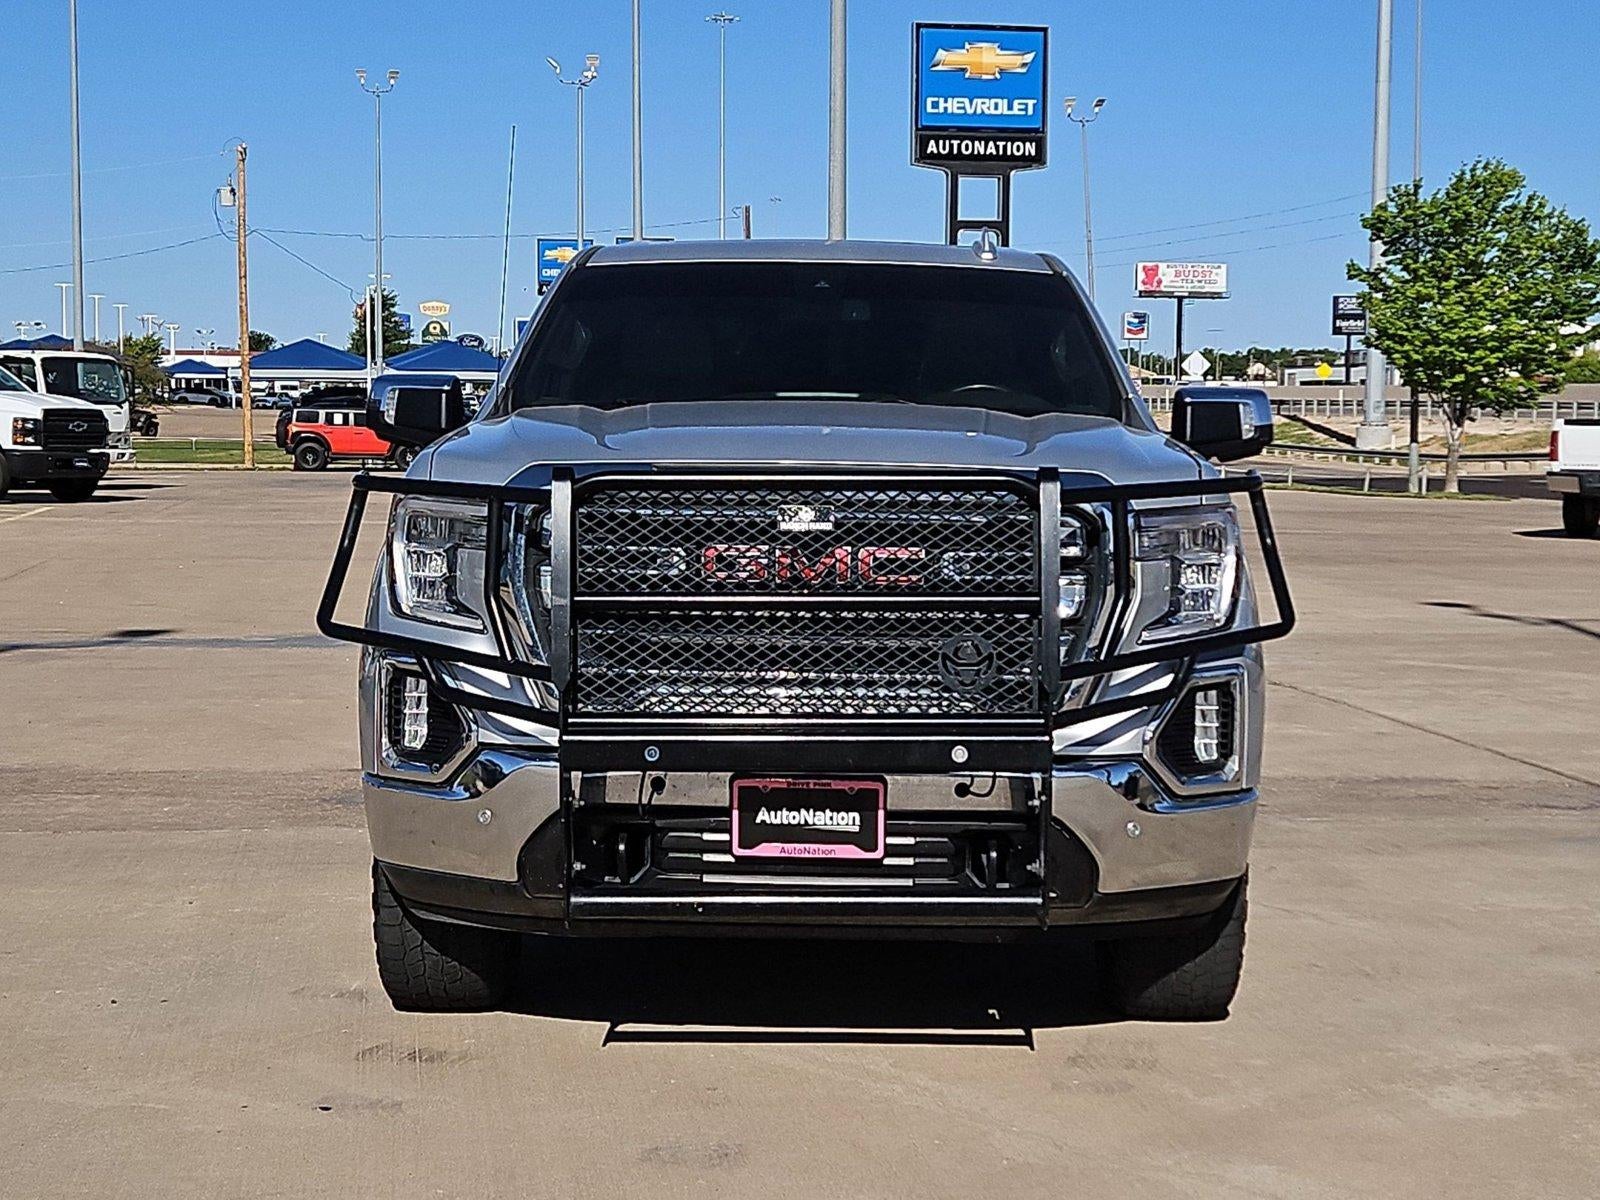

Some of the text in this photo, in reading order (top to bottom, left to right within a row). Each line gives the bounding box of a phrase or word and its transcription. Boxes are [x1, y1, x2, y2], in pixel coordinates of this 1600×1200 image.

[926, 97, 1037, 115] CHEVROLET
[926, 139, 1036, 156] AUTONATION
[1174, 269, 1214, 279] BUDS?
[702, 545, 925, 584] GMC
[755, 807, 861, 826] AutoNation
[779, 846, 836, 856] AutoNation
